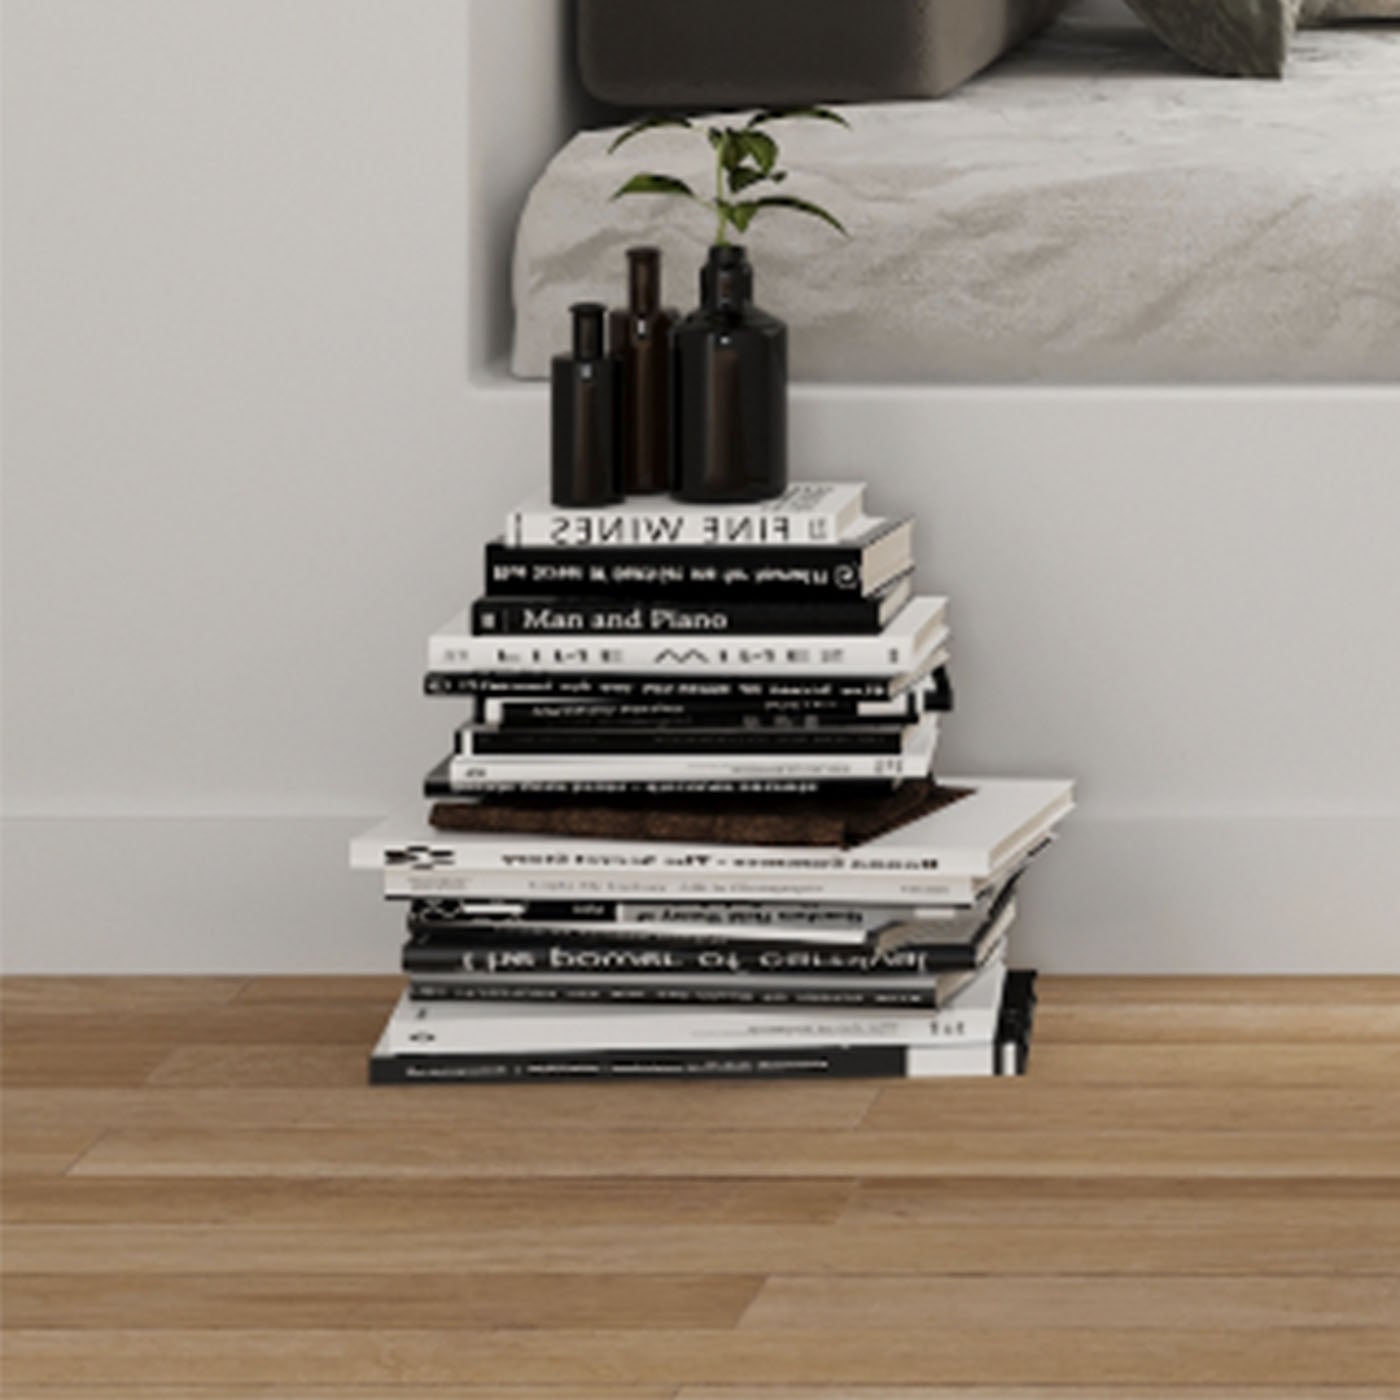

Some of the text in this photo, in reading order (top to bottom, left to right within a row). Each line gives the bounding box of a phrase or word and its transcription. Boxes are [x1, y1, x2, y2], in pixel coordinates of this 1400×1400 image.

[522, 608, 728, 630] Man and Piano
